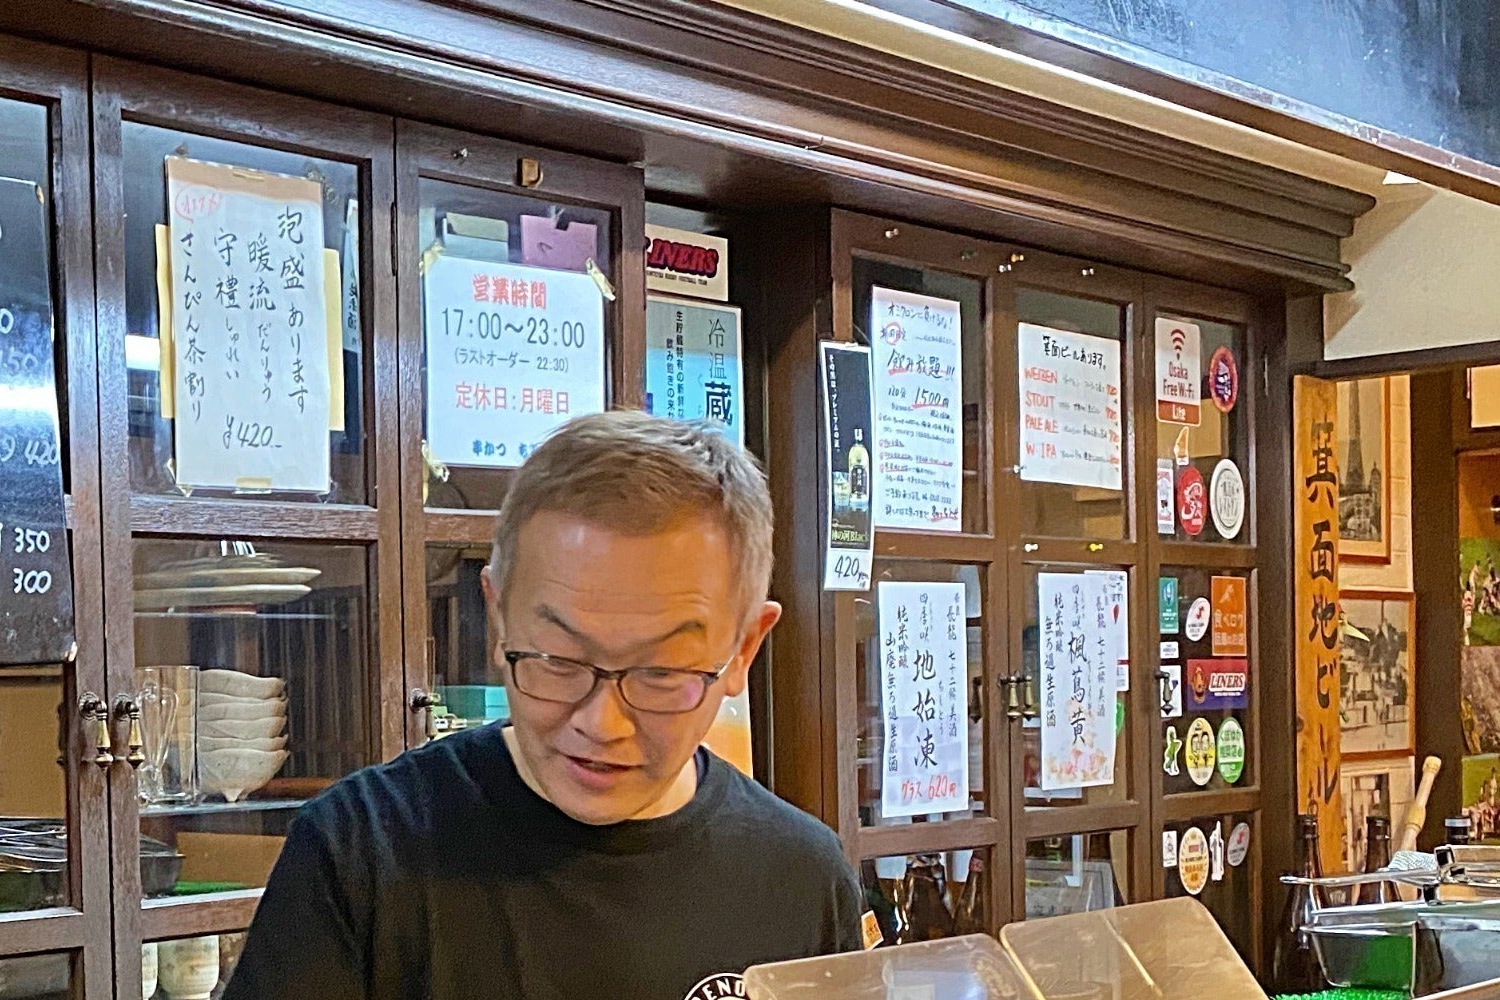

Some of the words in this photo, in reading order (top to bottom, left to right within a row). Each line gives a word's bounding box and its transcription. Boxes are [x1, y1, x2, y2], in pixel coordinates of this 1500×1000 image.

[248, 232, 275, 312] 暖流
[472, 274, 547, 309] 営業時間
[278, 206, 309, 413] 泡盛あります
[180, 233, 206, 424] さんぴん茶割り
[1168, 361, 1188, 380] Osaka
[455, 381, 569, 415] 定休日:月曜日
[1025, 390, 1056, 410] STOUT
[1025, 414, 1043, 430] PALE
[472, 439, 507, 457] 串かつ
[1040, 442, 1057, 460] IPA
[14, 527, 50, 552] 350
[834, 555, 860, 578] 420
[12, 567, 52, 594] 300
[1305, 417, 1339, 806] 箕面地ビール
[1210, 673, 1244, 689] LINERS
[911, 648, 938, 770] 地始凍
